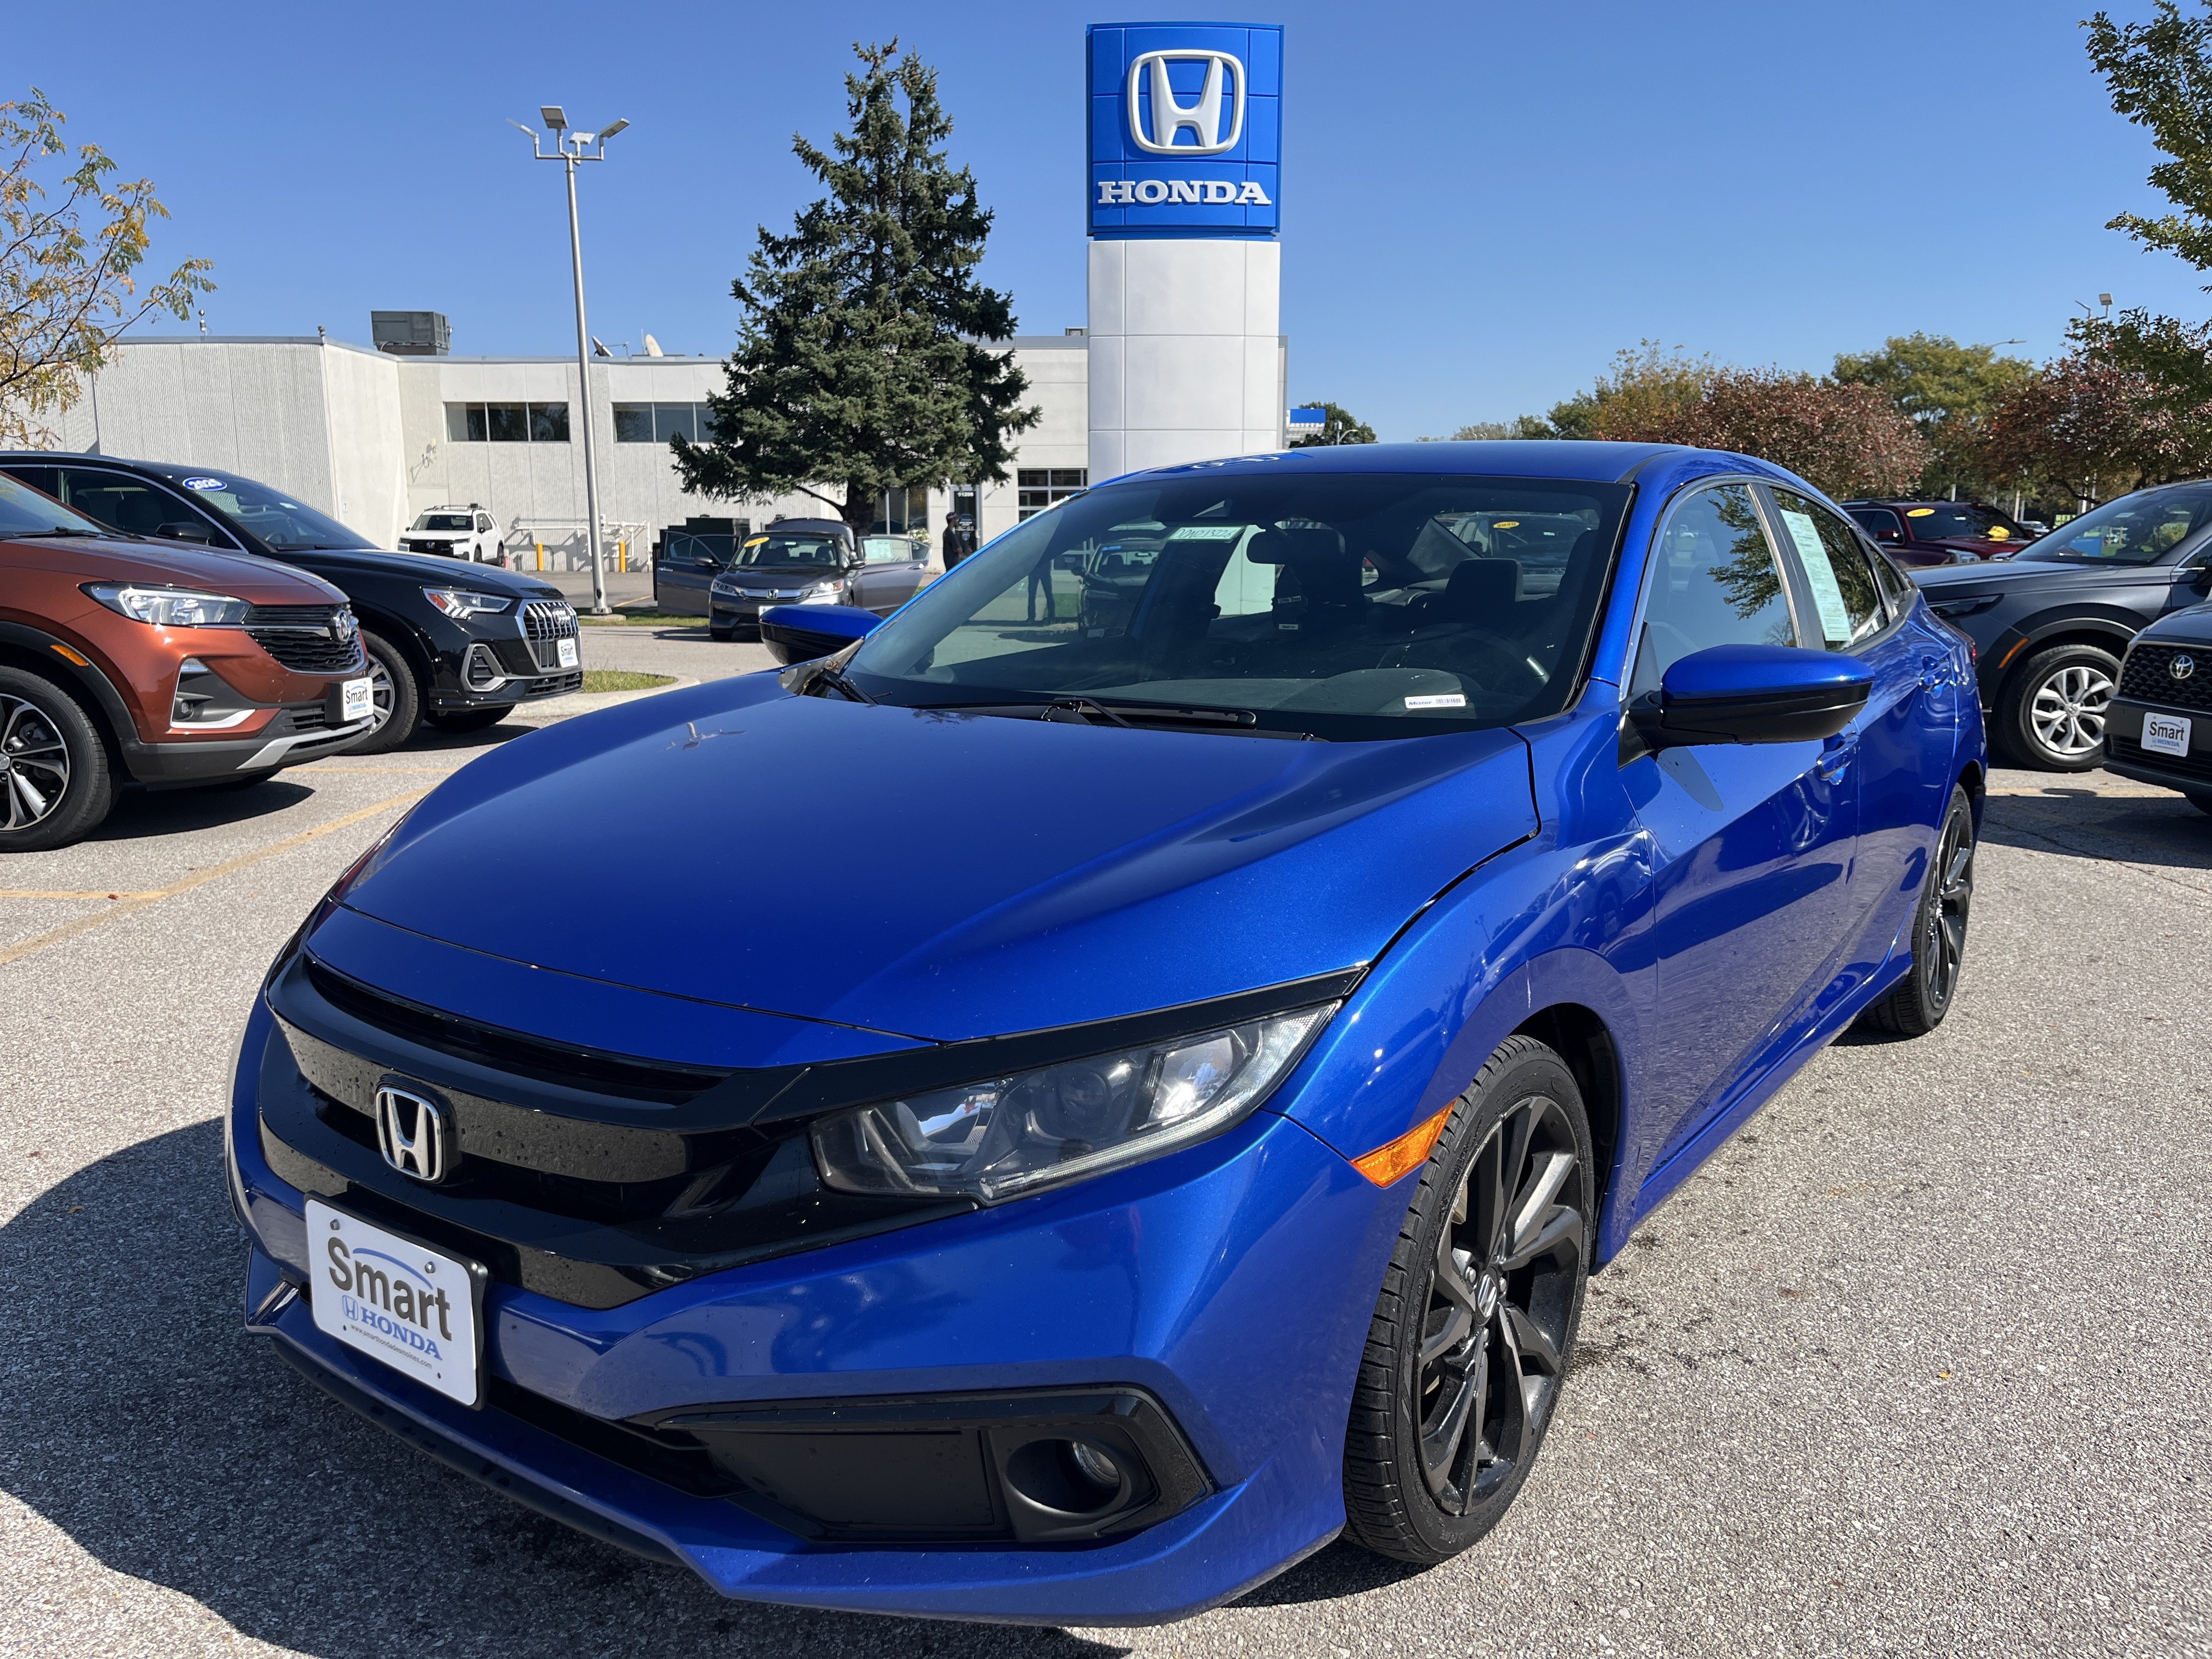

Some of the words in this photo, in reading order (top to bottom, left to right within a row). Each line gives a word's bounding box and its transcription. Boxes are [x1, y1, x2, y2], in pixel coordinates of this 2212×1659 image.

[1098, 180, 1272, 206] HONDA
[346, 687, 368, 704] Smart
[2149, 721, 2185, 741] Smart
[328, 1236, 453, 1342] Smart
[360, 1305, 443, 1361] HONDA
